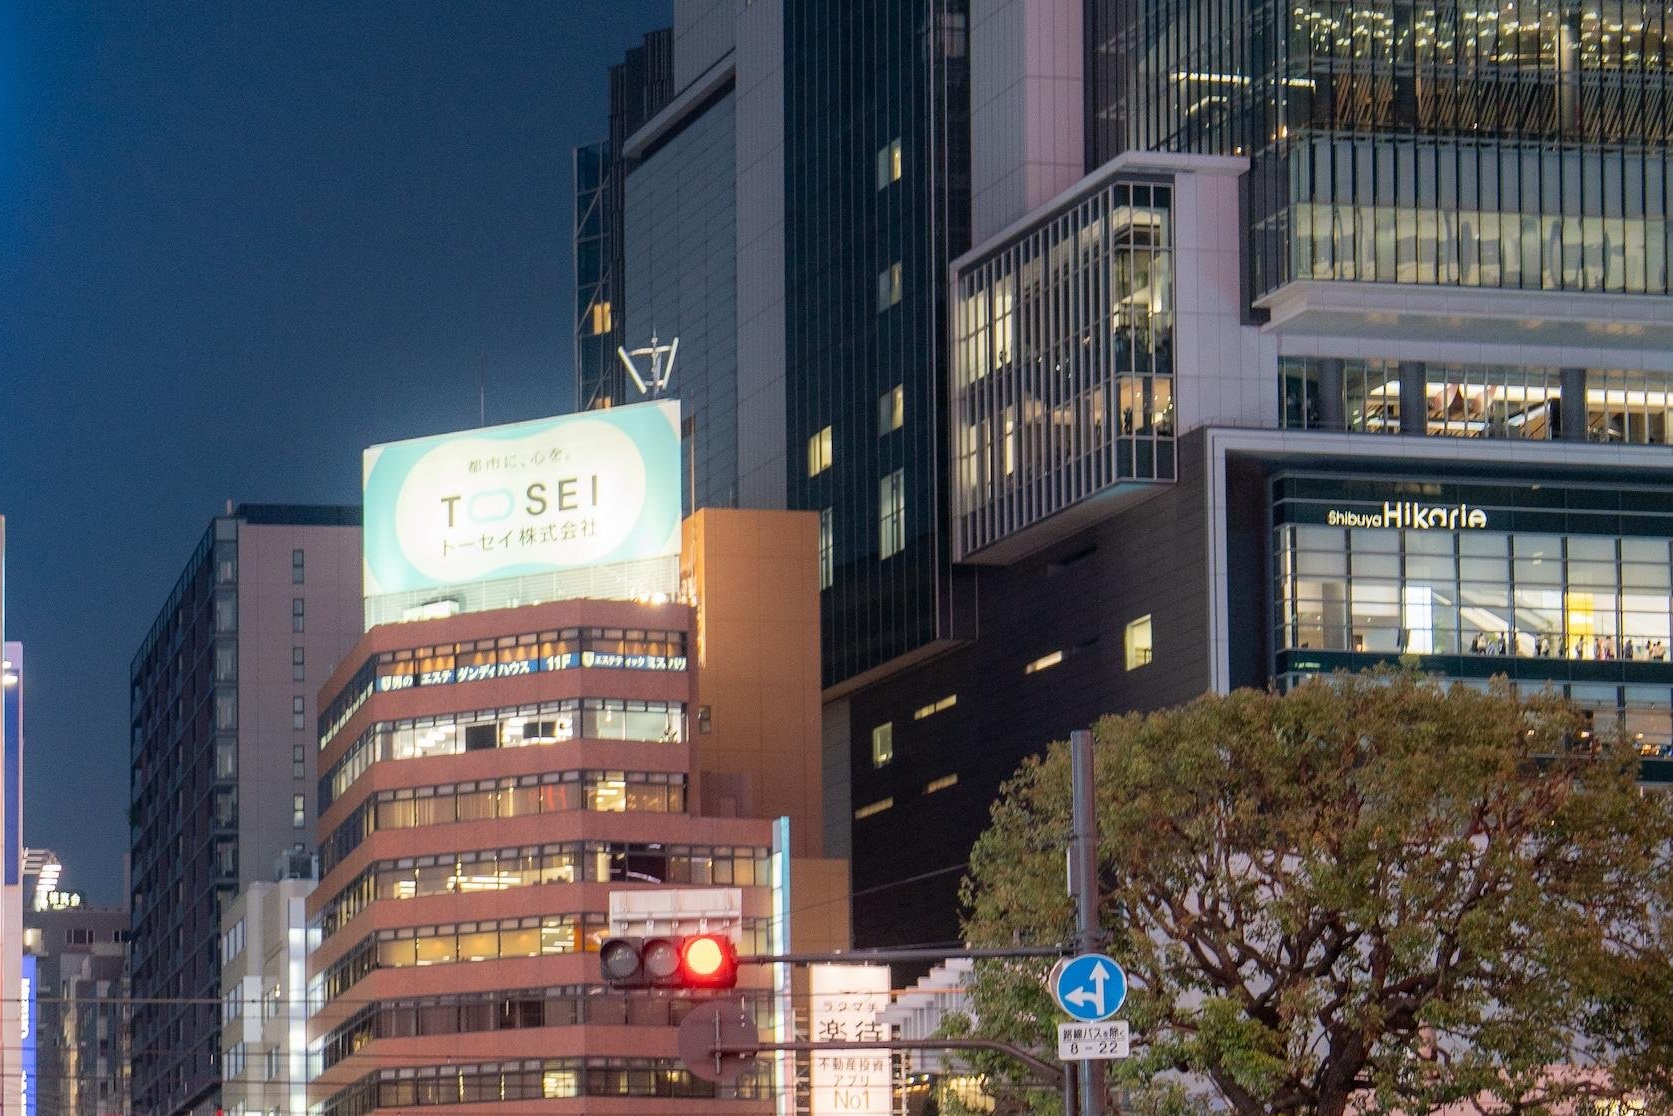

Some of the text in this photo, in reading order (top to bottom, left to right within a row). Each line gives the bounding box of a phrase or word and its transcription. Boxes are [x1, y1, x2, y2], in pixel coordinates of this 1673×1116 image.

[1328, 501, 1488, 530] Shibuya Hikarie
[442, 517, 599, 558] トーセイ株式会社
[546, 653, 572, 673] 11F
[1063, 1026, 1125, 1040] 路線バスを除く
[818, 1056, 884, 1072] 不動産投資
[833, 1074, 870, 1088] アプリ
